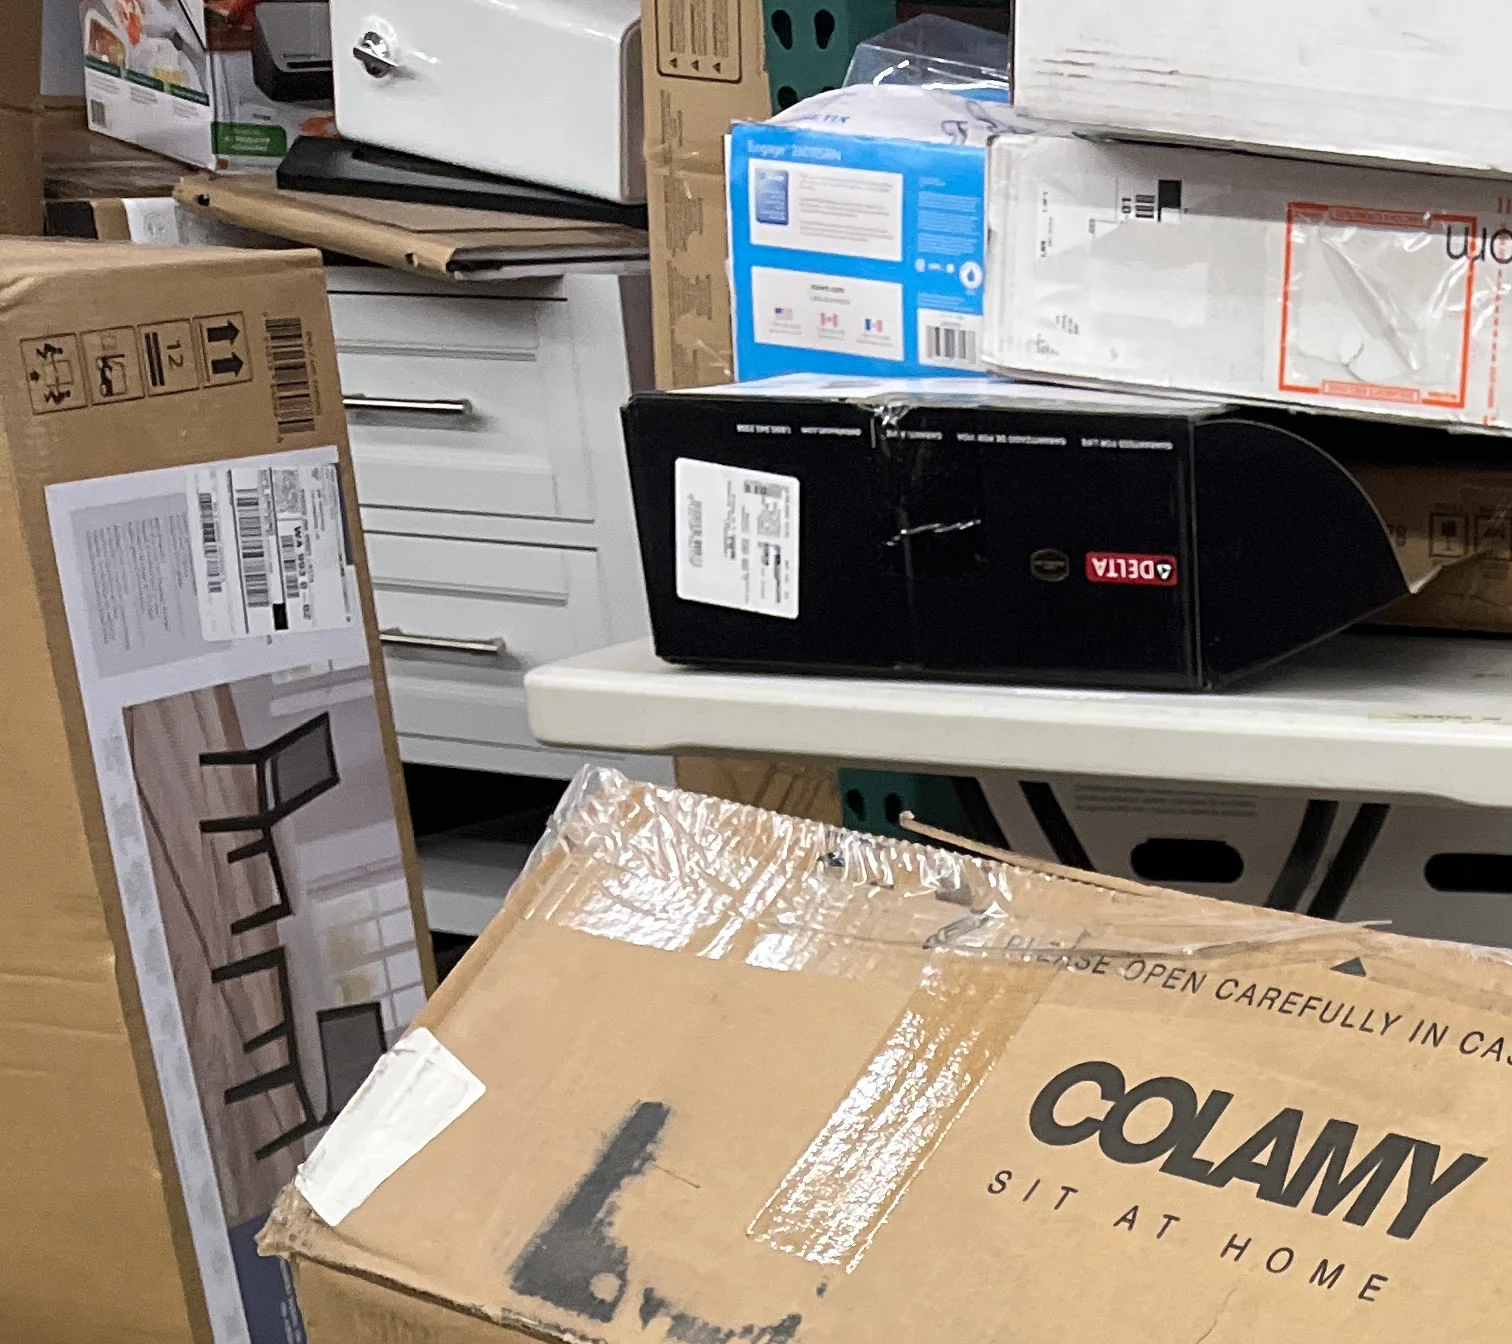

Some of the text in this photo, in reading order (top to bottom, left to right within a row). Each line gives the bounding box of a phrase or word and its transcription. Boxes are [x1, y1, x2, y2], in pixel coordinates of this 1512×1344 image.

[166, 339, 184, 371] 12
[1091, 557, 1156, 580] DELTA
[1123, 959, 1207, 995] OPEN
[1214, 977, 1402, 1037] CAREFULLY
[1408, 1019, 1450, 1049] IN
[1029, 1060, 1488, 1241] COLAMY
[987, 1169, 1389, 1303] SIT AT HOME
